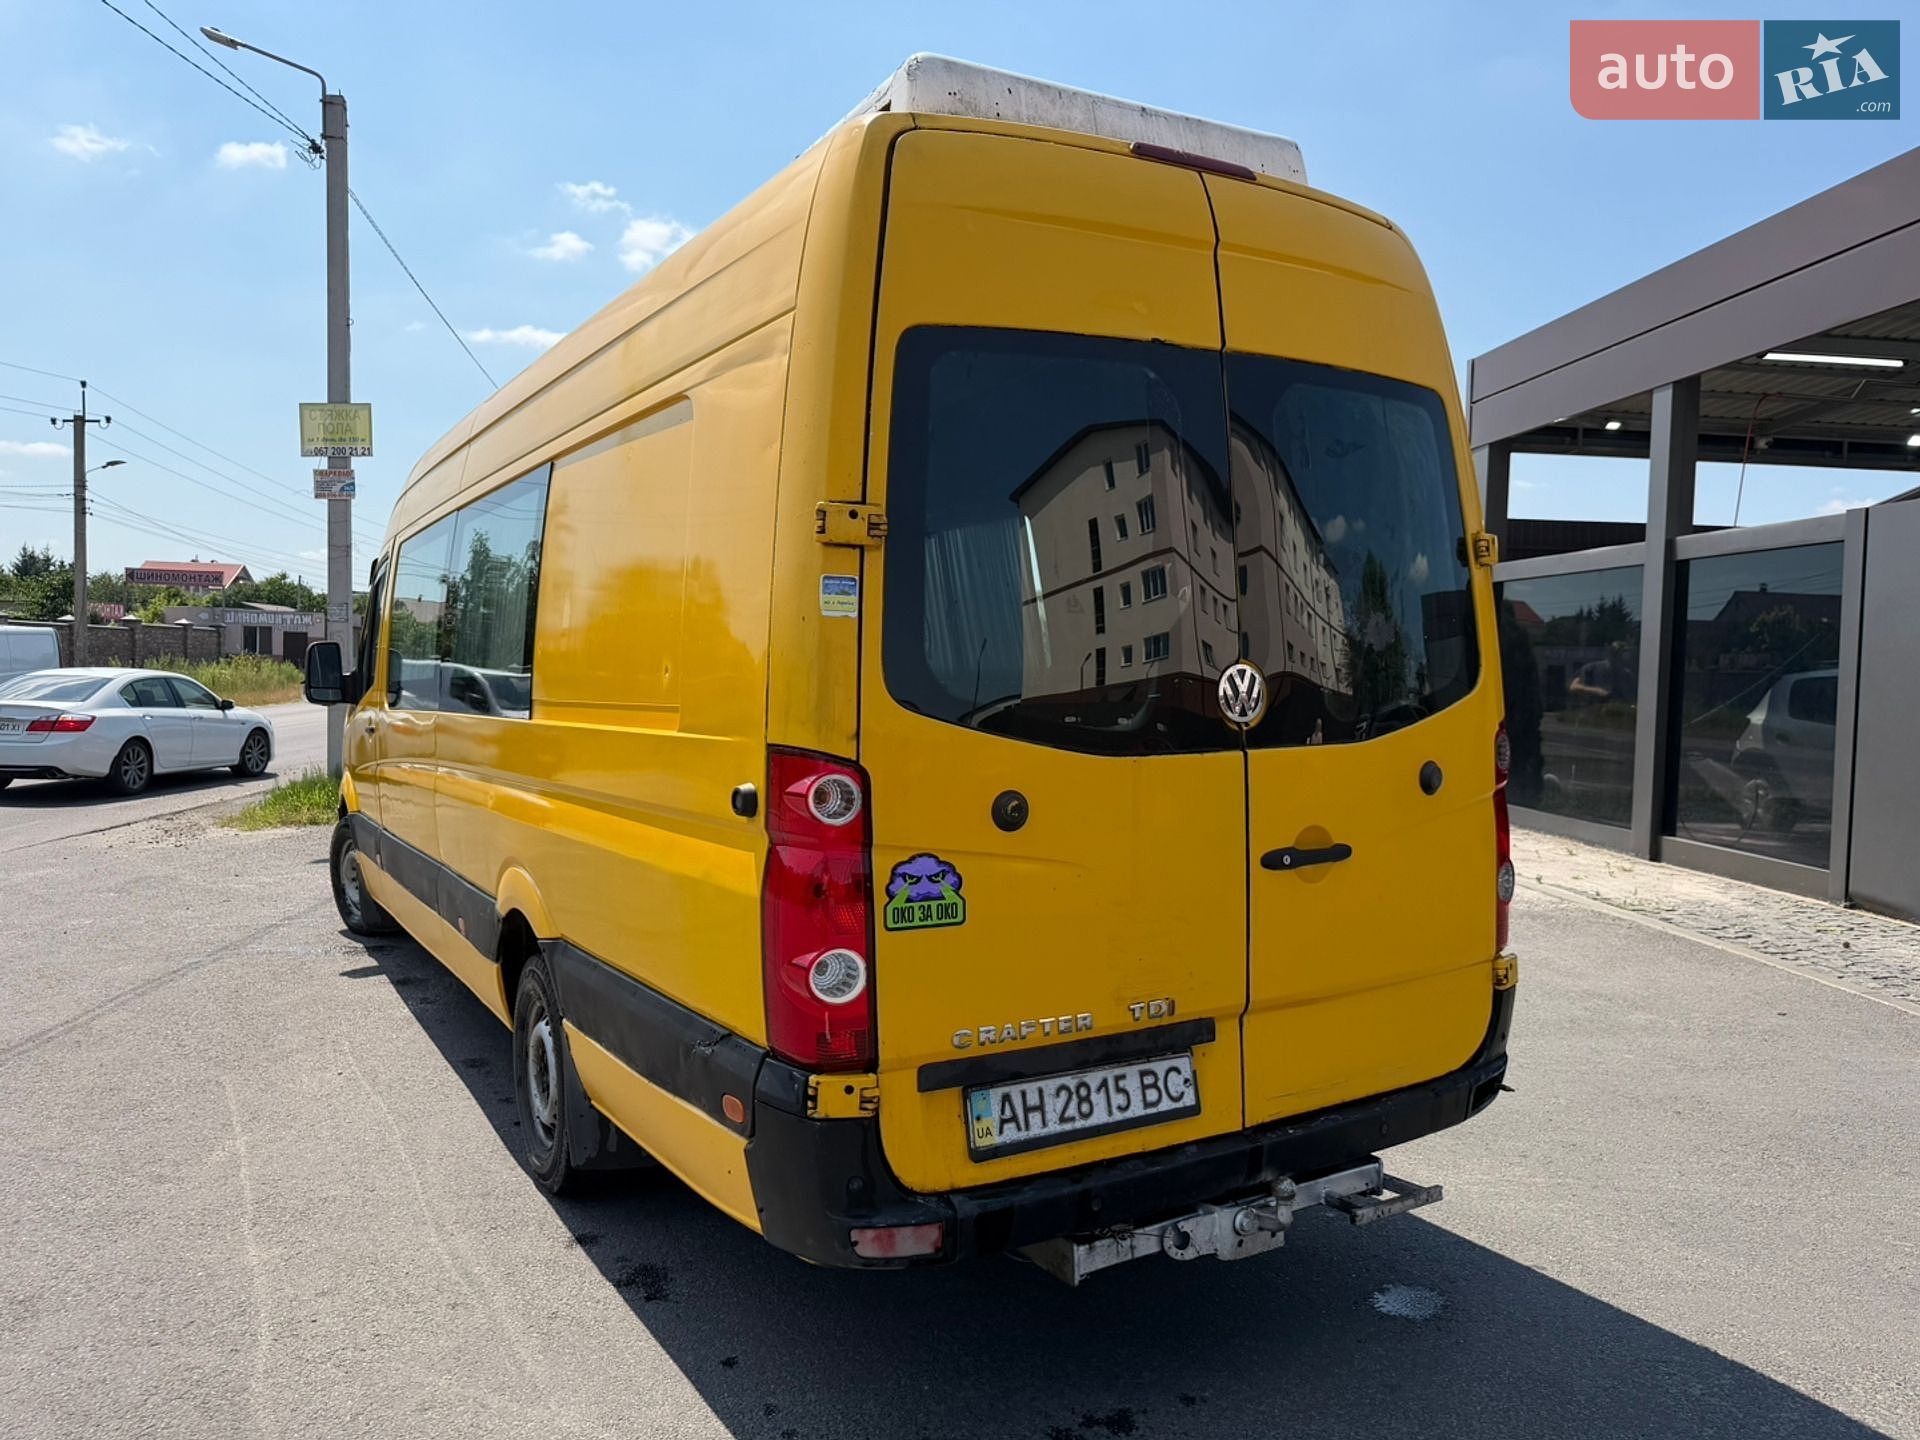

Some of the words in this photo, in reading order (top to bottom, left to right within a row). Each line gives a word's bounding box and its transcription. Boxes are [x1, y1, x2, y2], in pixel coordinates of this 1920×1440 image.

[309, 408, 361, 421] СТЯЖКА
[313, 446, 328, 457] 067
[331, 446, 347, 456] 200
[349, 446, 359, 456] 21
[360, 446, 371, 456] 21
[135, 570, 222, 585] ШИНОМОНТАЖ
[892, 905, 915, 925] ОКО
[918, 904, 933, 922] ЗА
[937, 902, 958, 921] ОКО
[951, 1012, 1094, 1050] CRAFTER
[976, 1123, 994, 1140] UA
[997, 1085, 1049, 1137] AH
[1055, 1073, 1131, 1127] 2815
[1139, 1065, 1186, 1111] BC
